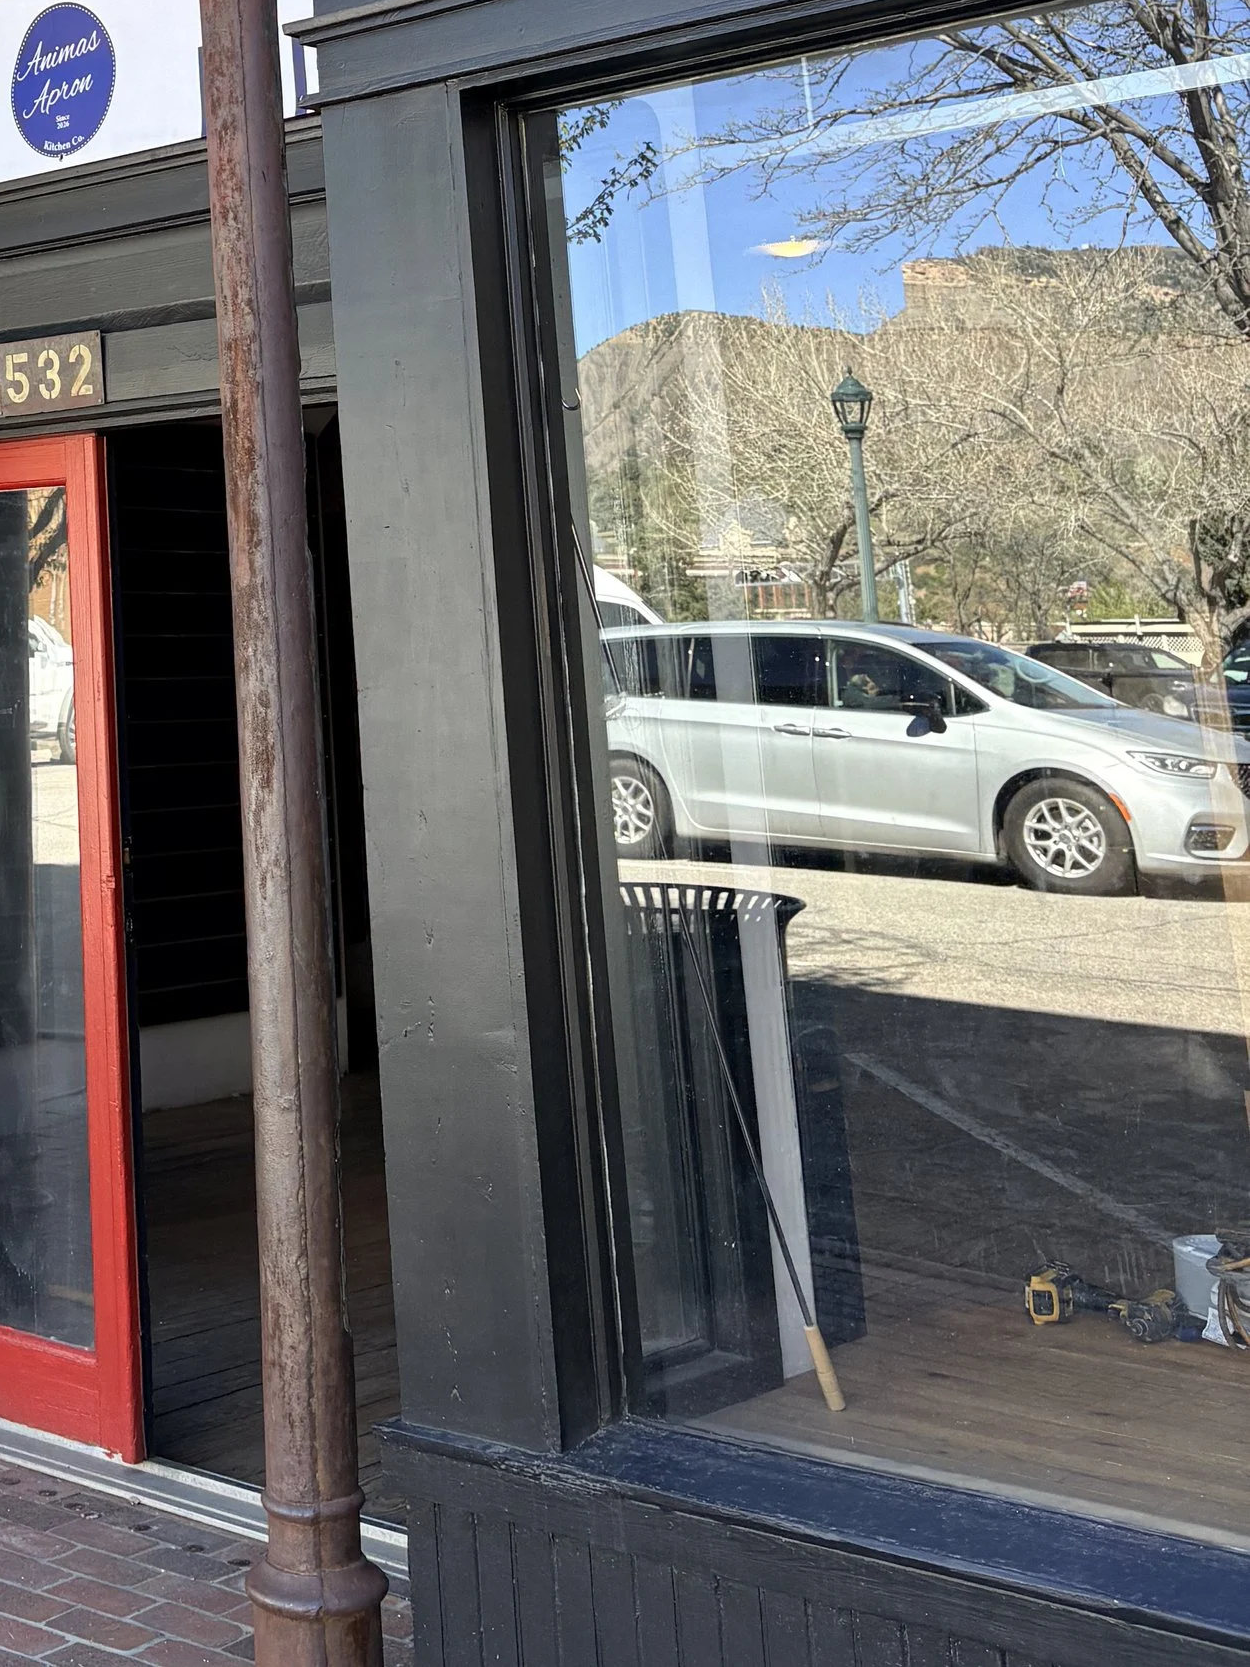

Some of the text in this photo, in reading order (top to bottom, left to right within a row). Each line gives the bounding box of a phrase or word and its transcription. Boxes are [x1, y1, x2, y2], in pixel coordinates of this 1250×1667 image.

[16, 29, 101, 81] Animas
[22, 74, 94, 119] Apron
[43, 135, 85, 152] Kitchen Co.
[5, 344, 94, 404] 532
